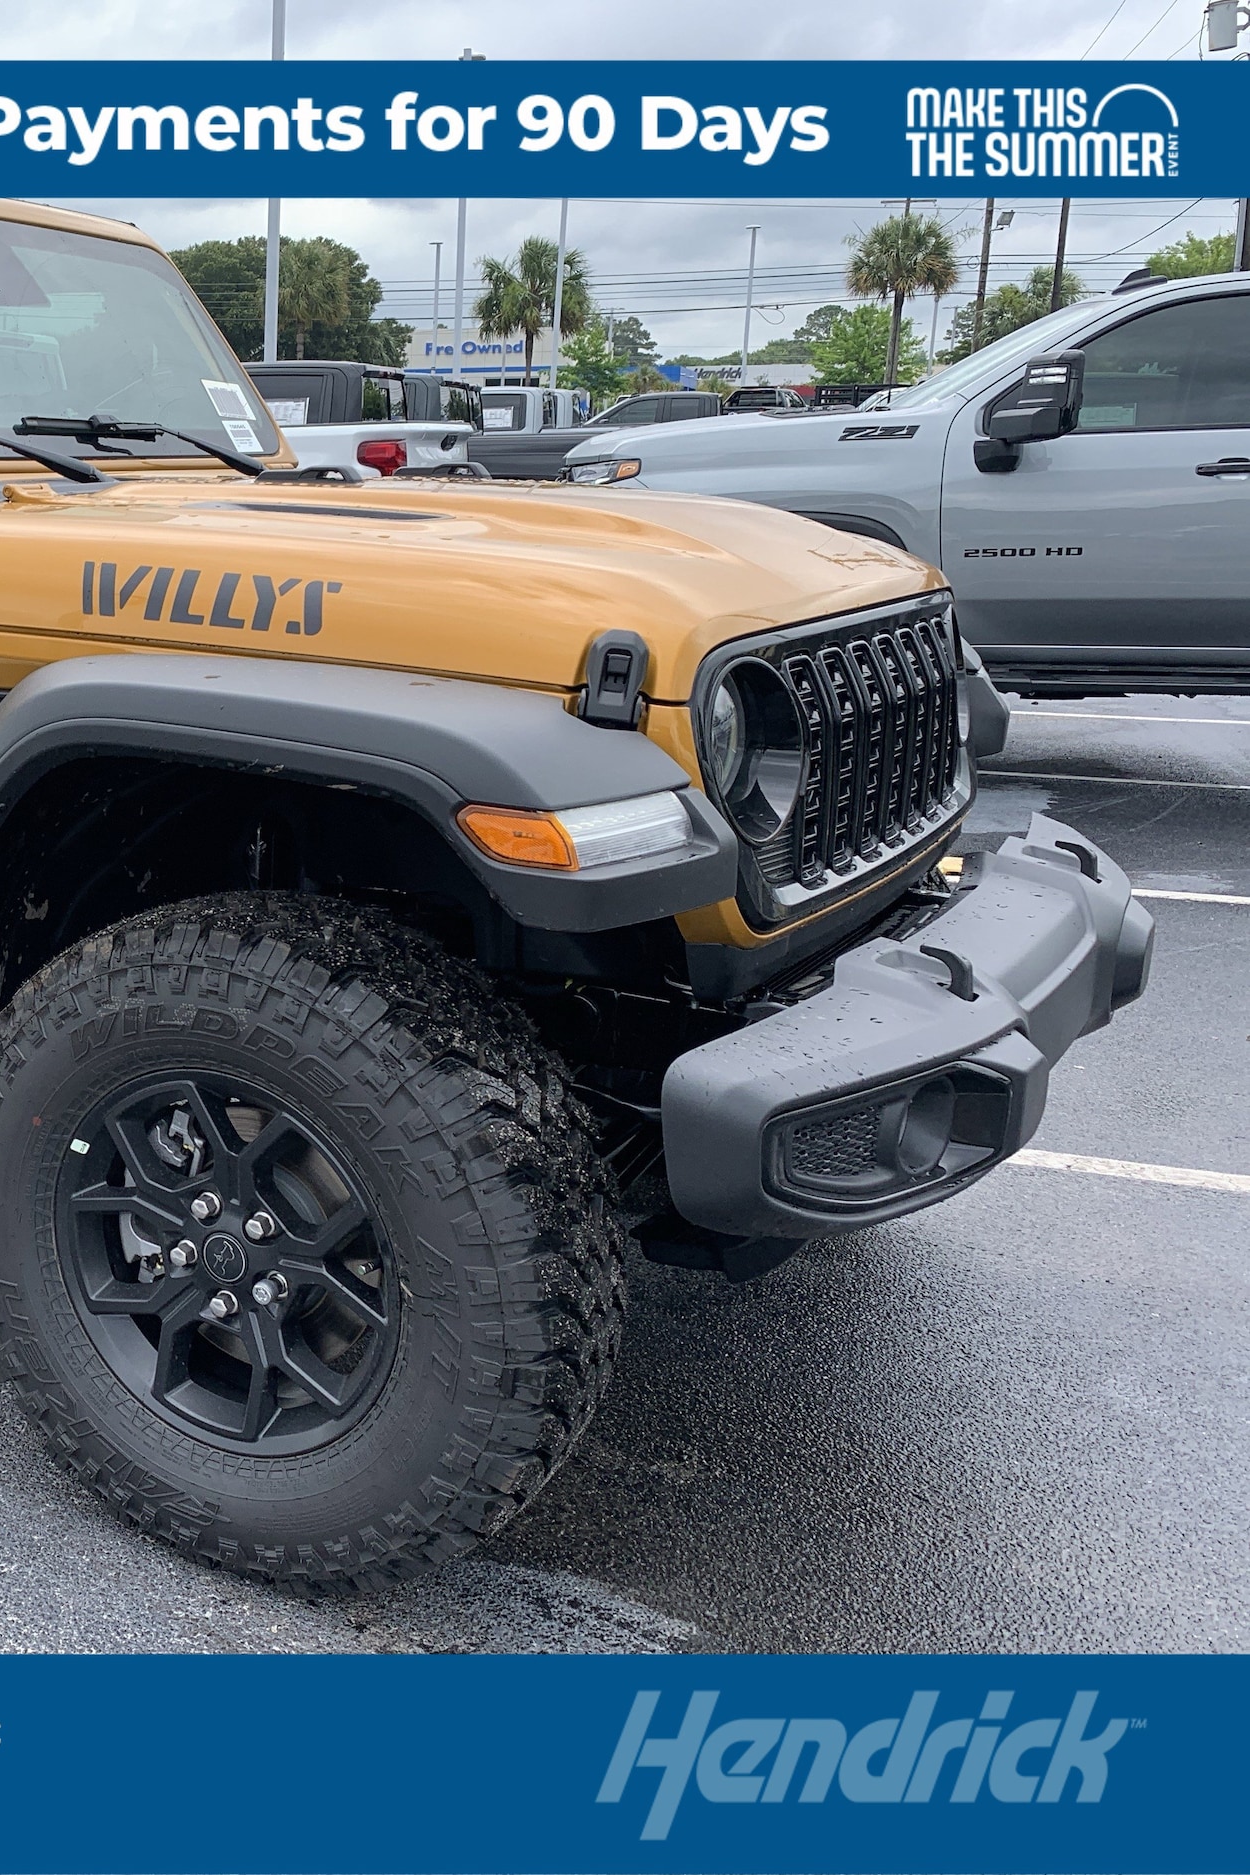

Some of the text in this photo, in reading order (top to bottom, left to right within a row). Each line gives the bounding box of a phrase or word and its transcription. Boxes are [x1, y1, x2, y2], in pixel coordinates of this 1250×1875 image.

[964, 547, 1083, 558] 2500 HD
[82, 561, 343, 636] WILLYS
[69, 1003, 428, 1197] WILDPEAK
